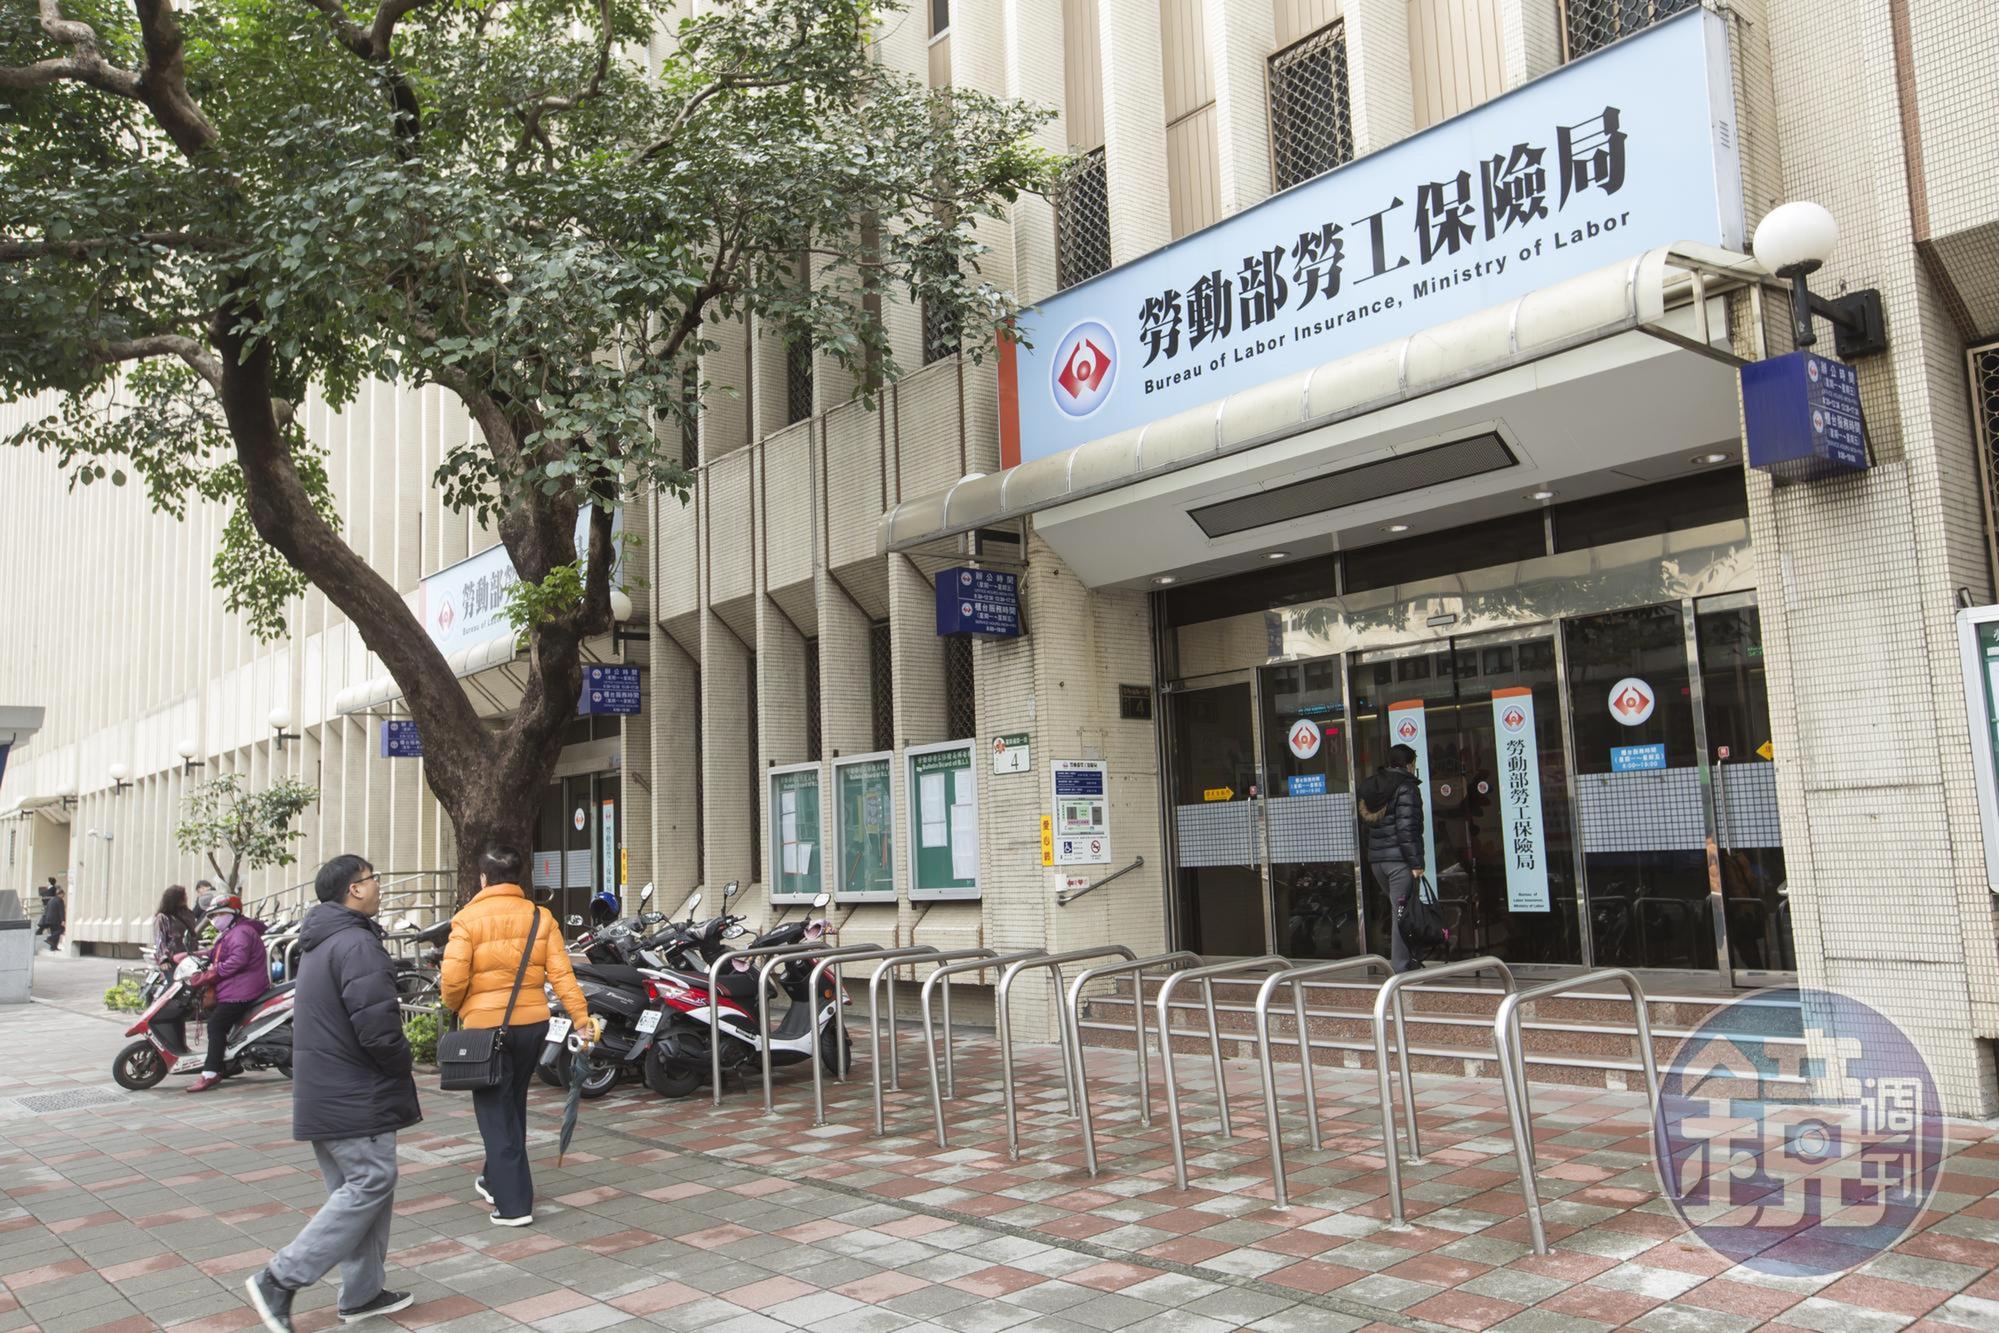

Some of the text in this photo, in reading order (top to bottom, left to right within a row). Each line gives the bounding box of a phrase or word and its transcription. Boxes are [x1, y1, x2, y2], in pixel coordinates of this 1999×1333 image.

[1138, 106, 1629, 368] 勞動部勞工保險局
[1144, 211, 1630, 394] Bureau of Labor Insurance, Ministry of Labor
[1011, 753, 1020, 770] 4
[1506, 739, 1535, 871] 勞動部勞工保險局
